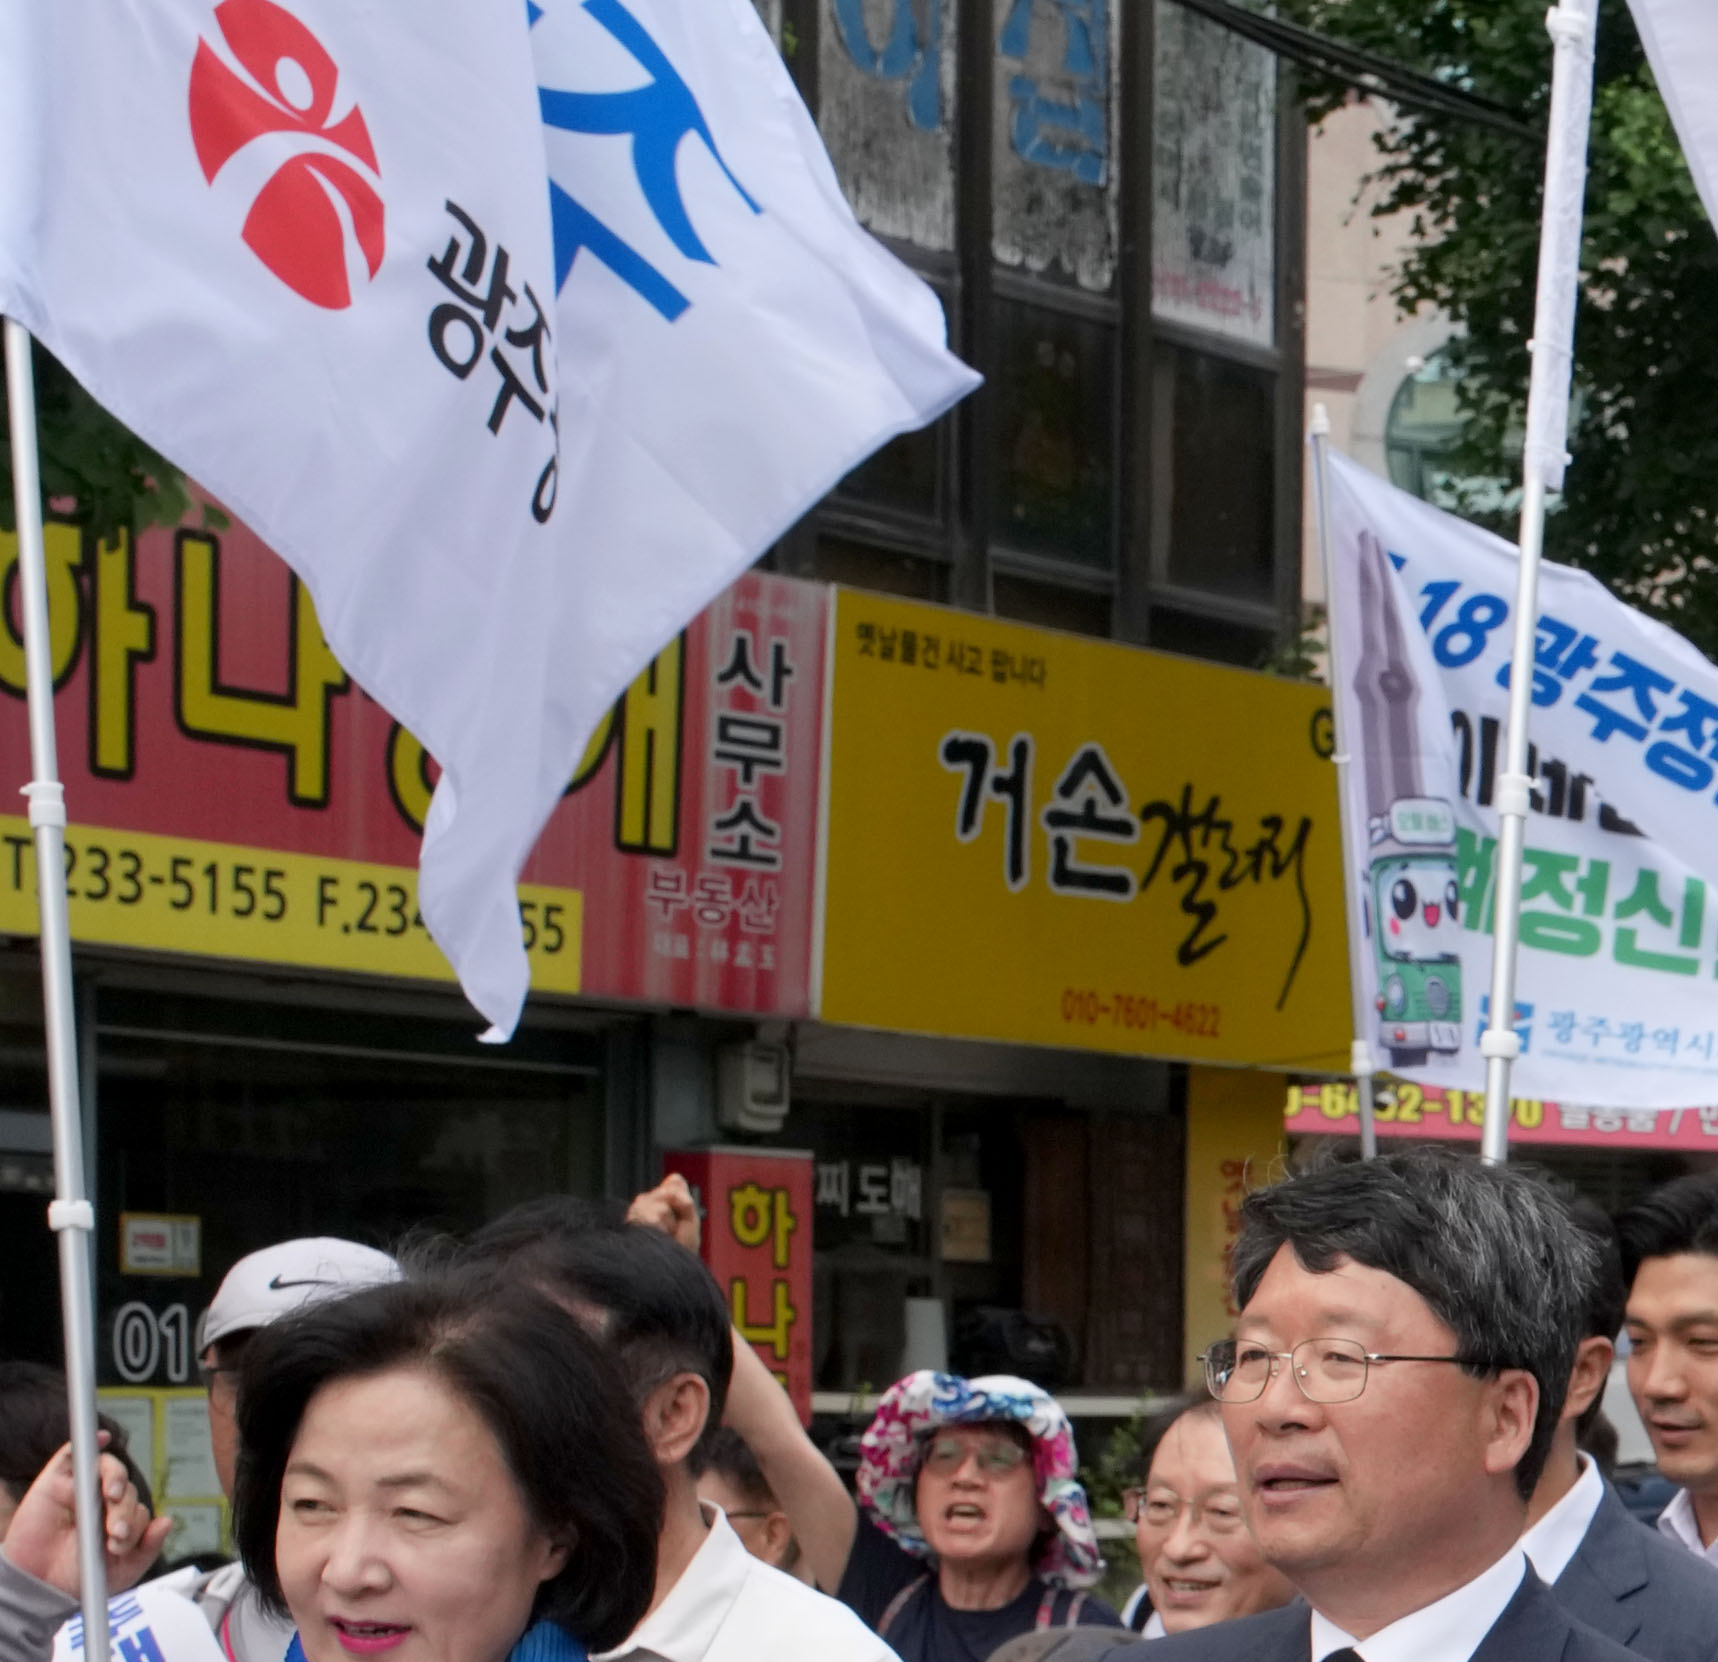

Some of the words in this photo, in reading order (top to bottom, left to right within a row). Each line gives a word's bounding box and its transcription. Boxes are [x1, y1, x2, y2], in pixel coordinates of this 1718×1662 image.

[710, 633, 794, 866] 사무소
[941, 731, 1138, 902] 거손
[647, 866, 781, 932] 부동산
[730, 1183, 797, 1390] 하나
